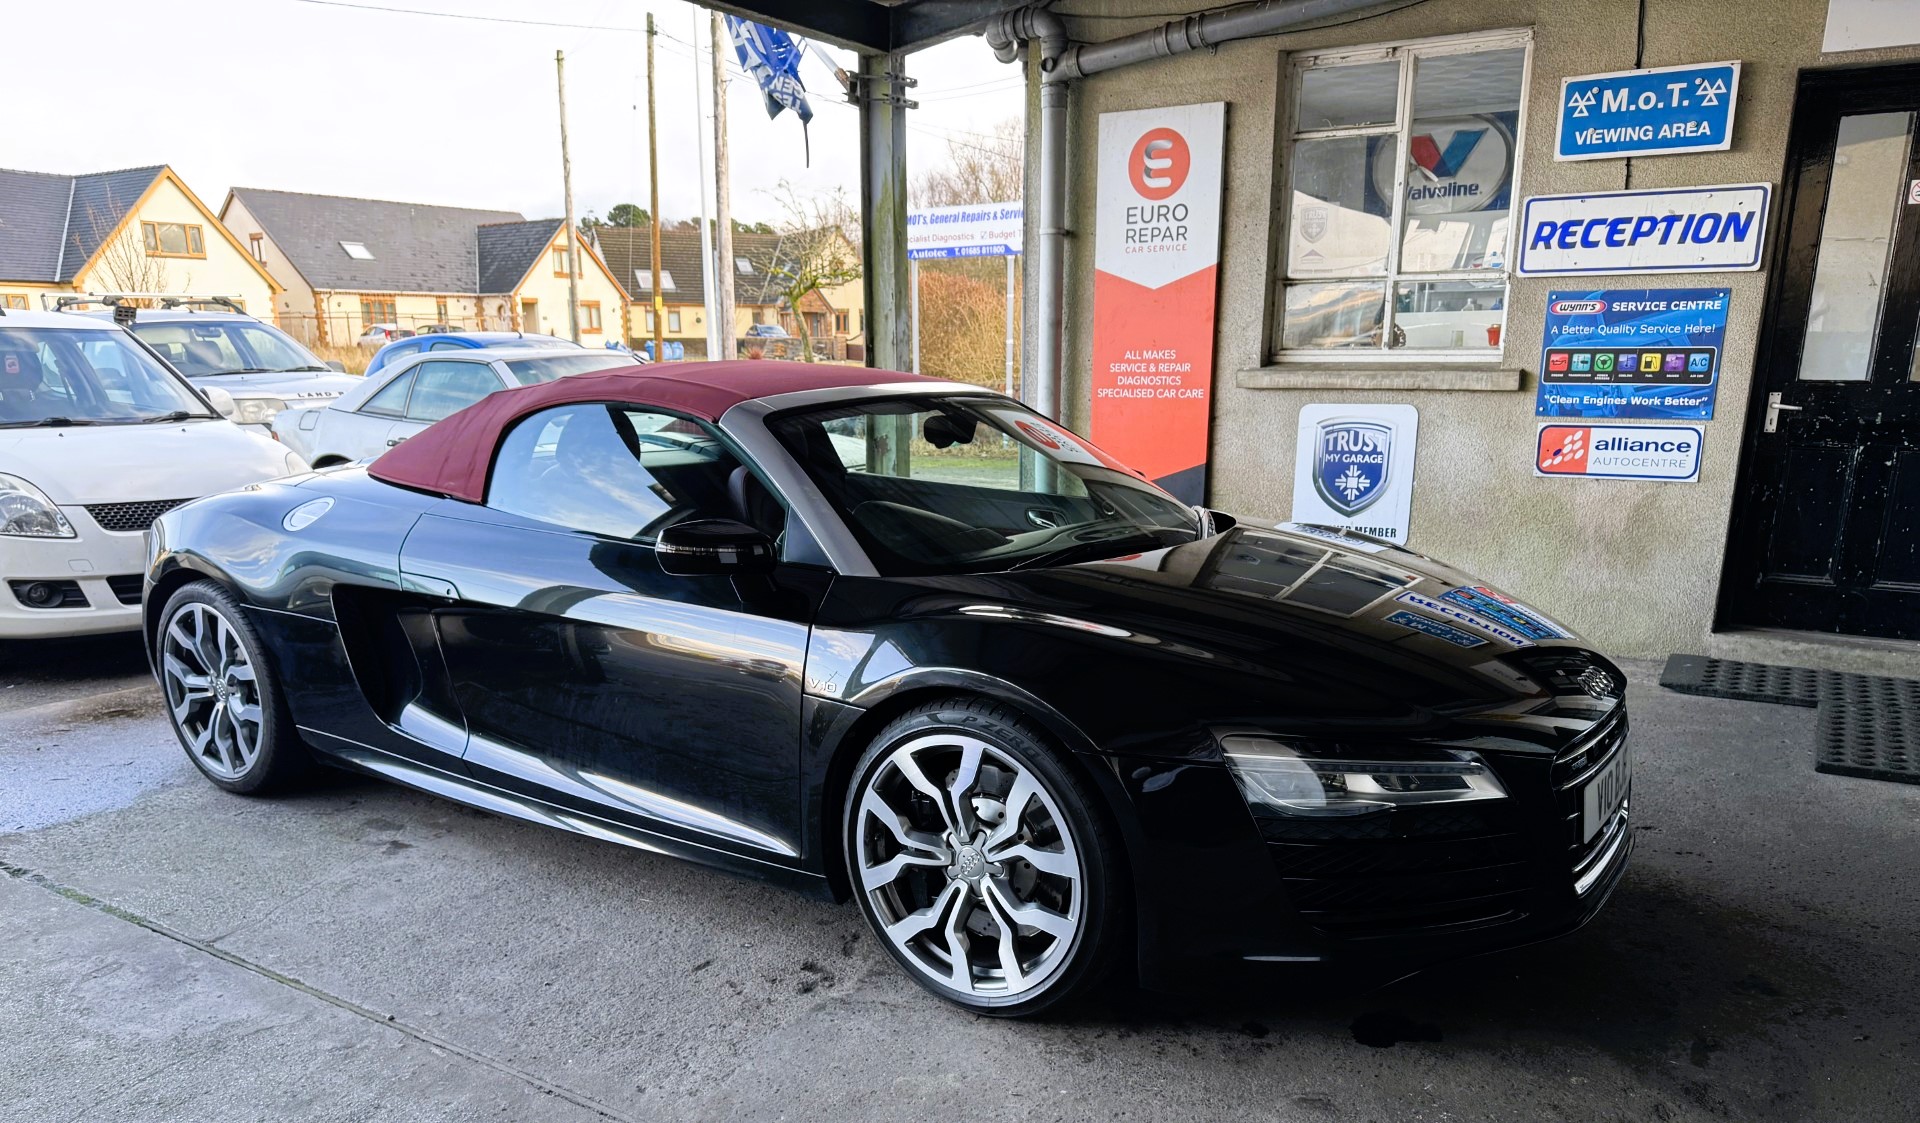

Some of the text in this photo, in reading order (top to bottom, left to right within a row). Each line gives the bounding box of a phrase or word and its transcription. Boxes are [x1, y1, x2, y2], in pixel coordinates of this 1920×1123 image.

[1601, 82, 1689, 113] M.o.T.
[1575, 121, 1711, 146] VIEWING AREA
[930, 212, 960, 225] General
[961, 210, 991, 223] Repairs
[992, 211, 998, 221] &
[1126, 203, 1189, 225] EURO
[932, 234, 975, 244] Diagnostics
[989, 230, 1016, 240] Budget
[1125, 225, 1188, 244] REPAR
[1529, 211, 1756, 251] RECEPTION
[911, 249, 948, 258] Autotec
[1125, 244, 1187, 254] CAR SERVICE
[1612, 301, 1666, 312] SERVICE
[1671, 300, 1722, 310] CENTRE
[1551, 324, 1716, 335] A Better Quality Service Here!
[1124, 349, 1176, 360] ALL MAKES
[1110, 363, 1191, 373] SERVICE & REPAIR
[1690, 358, 1707, 367] A/C
[1117, 376, 1181, 386] DIAGNOSTICS
[1097, 388, 1204, 399] SPECIALISED CAR CARE
[1583, 395, 1627, 406] Engines
[1631, 395, 1661, 405] Work
[1325, 430, 1386, 452] TRUST
[1595, 437, 1691, 453] alliance
[1325, 453, 1384, 464] MY GARAGE
[1593, 456, 1687, 469] AUTOCENTRE
[809, 678, 836, 693] V10
[961, 716, 1040, 758] P ZERO
